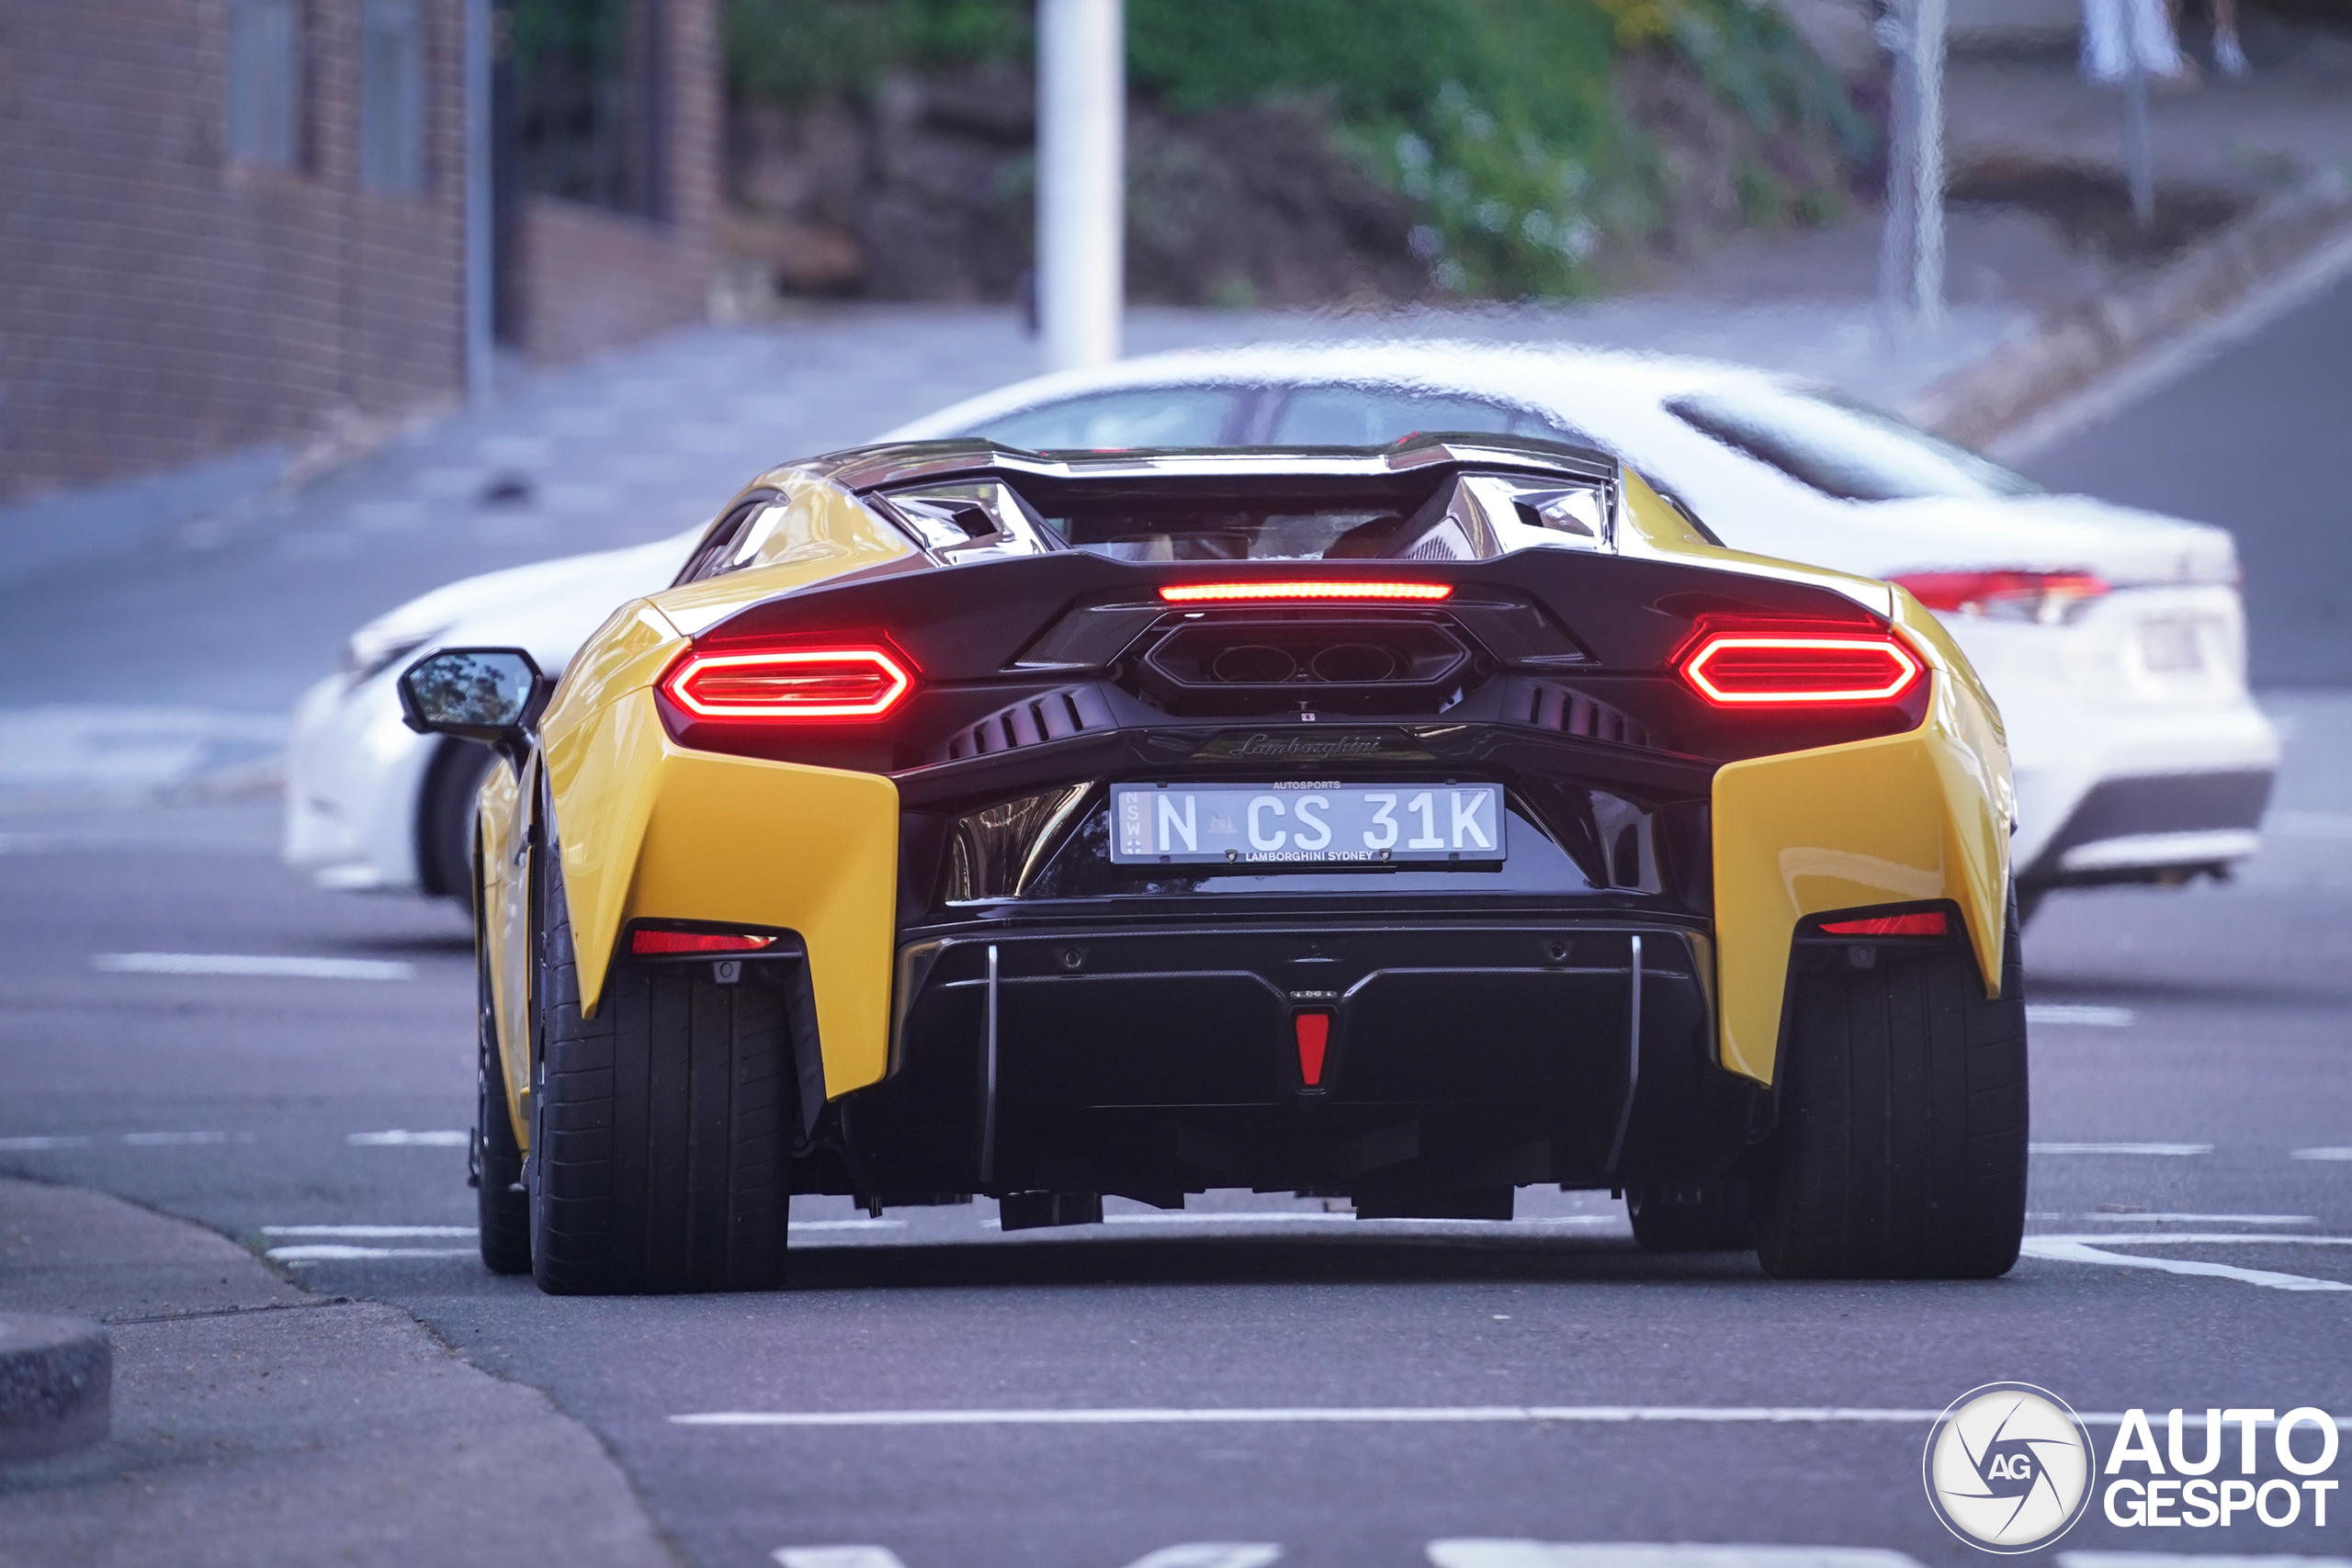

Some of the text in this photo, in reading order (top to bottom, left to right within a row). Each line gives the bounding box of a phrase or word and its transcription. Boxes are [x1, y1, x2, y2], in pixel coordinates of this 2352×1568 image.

[1229, 734, 1382, 758] Lamborghini
[1272, 781, 1340, 790] AUTOSPORTS
[1125, 792, 1140, 836] NSW
[1158, 791, 1491, 852] N CS 31K
[1245, 851, 1374, 862] LAMBORGHINI SYDNEY
